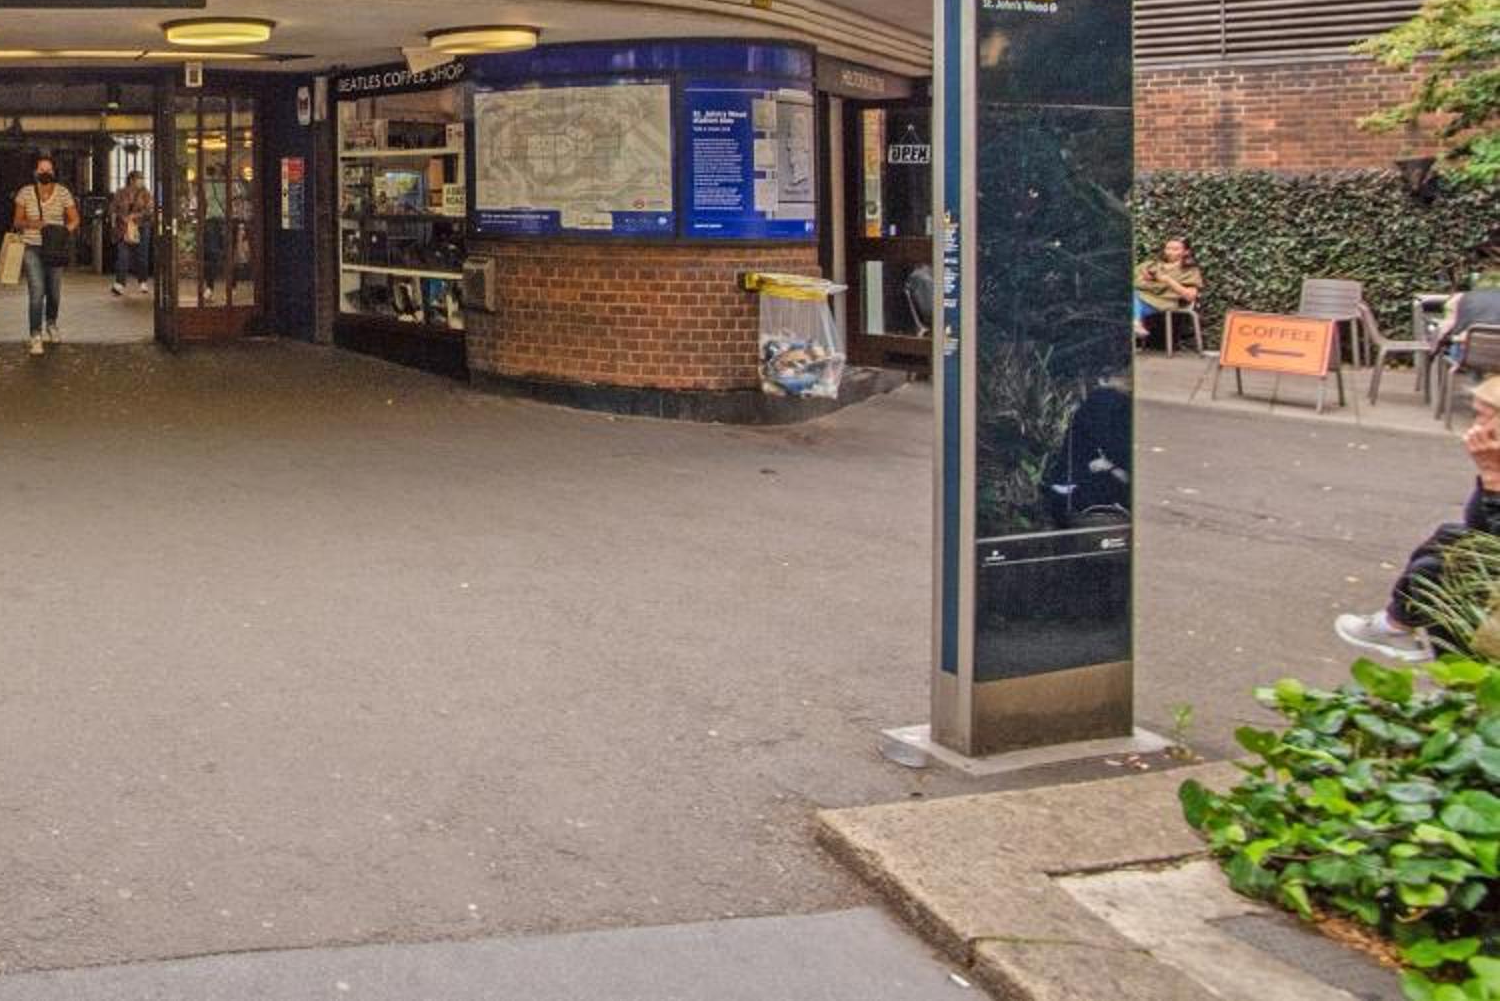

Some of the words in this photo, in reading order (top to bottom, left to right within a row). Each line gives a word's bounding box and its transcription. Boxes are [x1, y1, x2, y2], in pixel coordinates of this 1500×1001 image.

[339, 73, 381, 92] BEATLES
[383, 71, 427, 87] COFFEE
[431, 64, 465, 82] SHOP
[892, 145, 929, 163] OPEN
[1238, 324, 1317, 342] COFFEE
